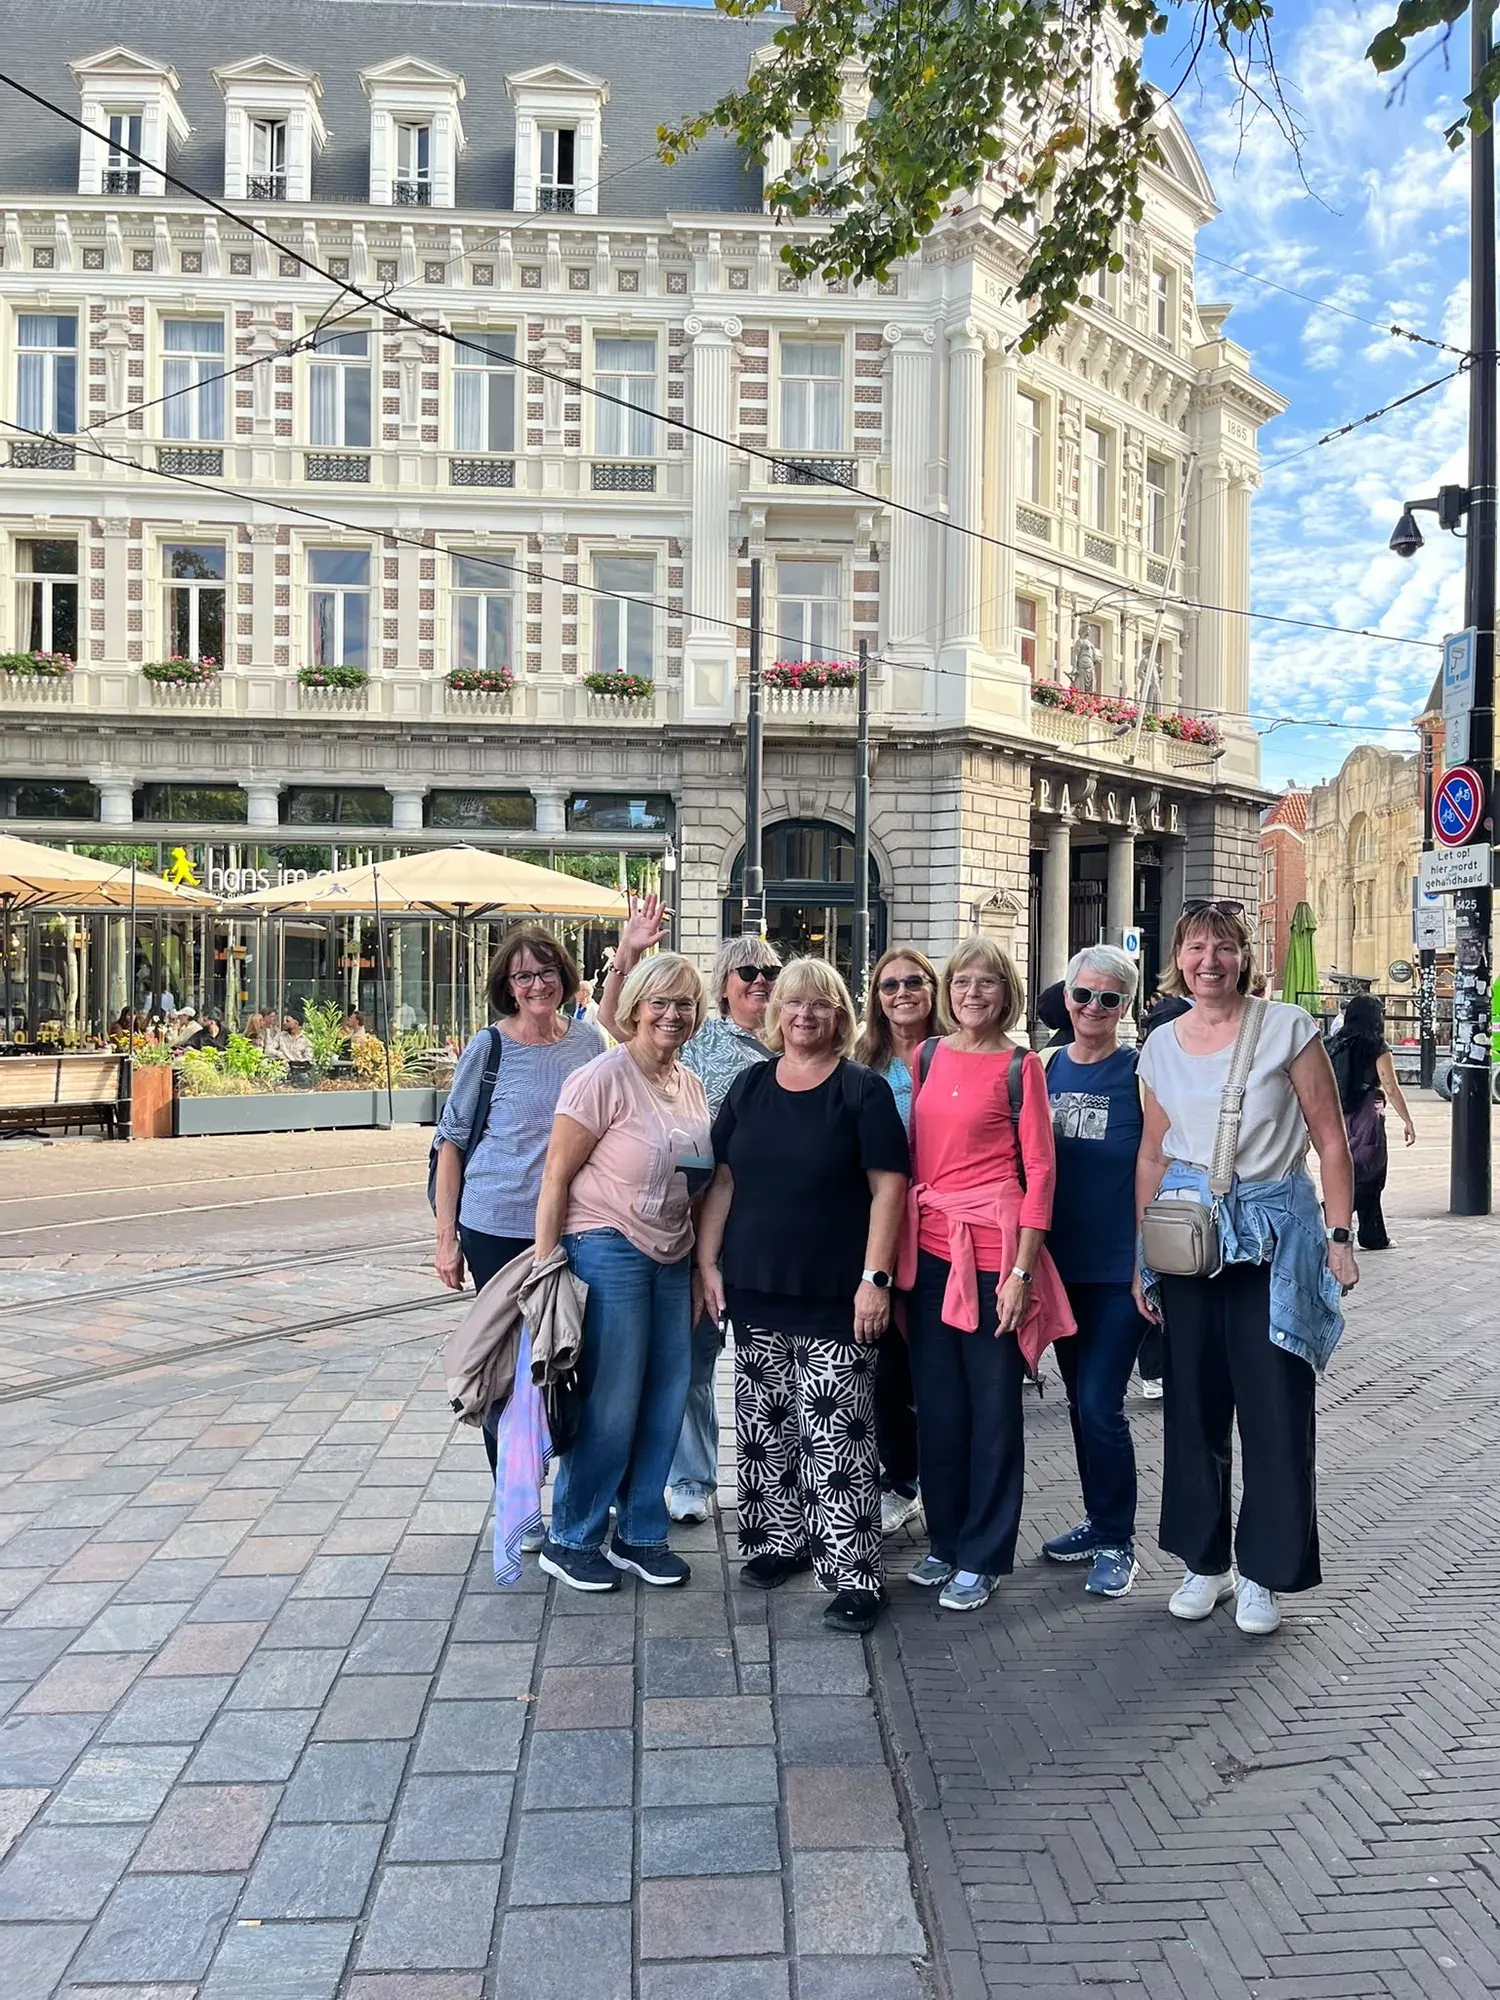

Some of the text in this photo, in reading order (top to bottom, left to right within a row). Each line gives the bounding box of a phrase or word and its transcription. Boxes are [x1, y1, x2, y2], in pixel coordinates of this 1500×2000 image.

[1228, 420, 1247, 442] 1885
[1039, 778, 1178, 832] PASSAGE
[1438, 848, 1470, 861] Let op!
[208, 847, 271, 892] hans
[1431, 861, 1477, 874] hier wordt
[1425, 873, 1482, 890] gehandhaafd
